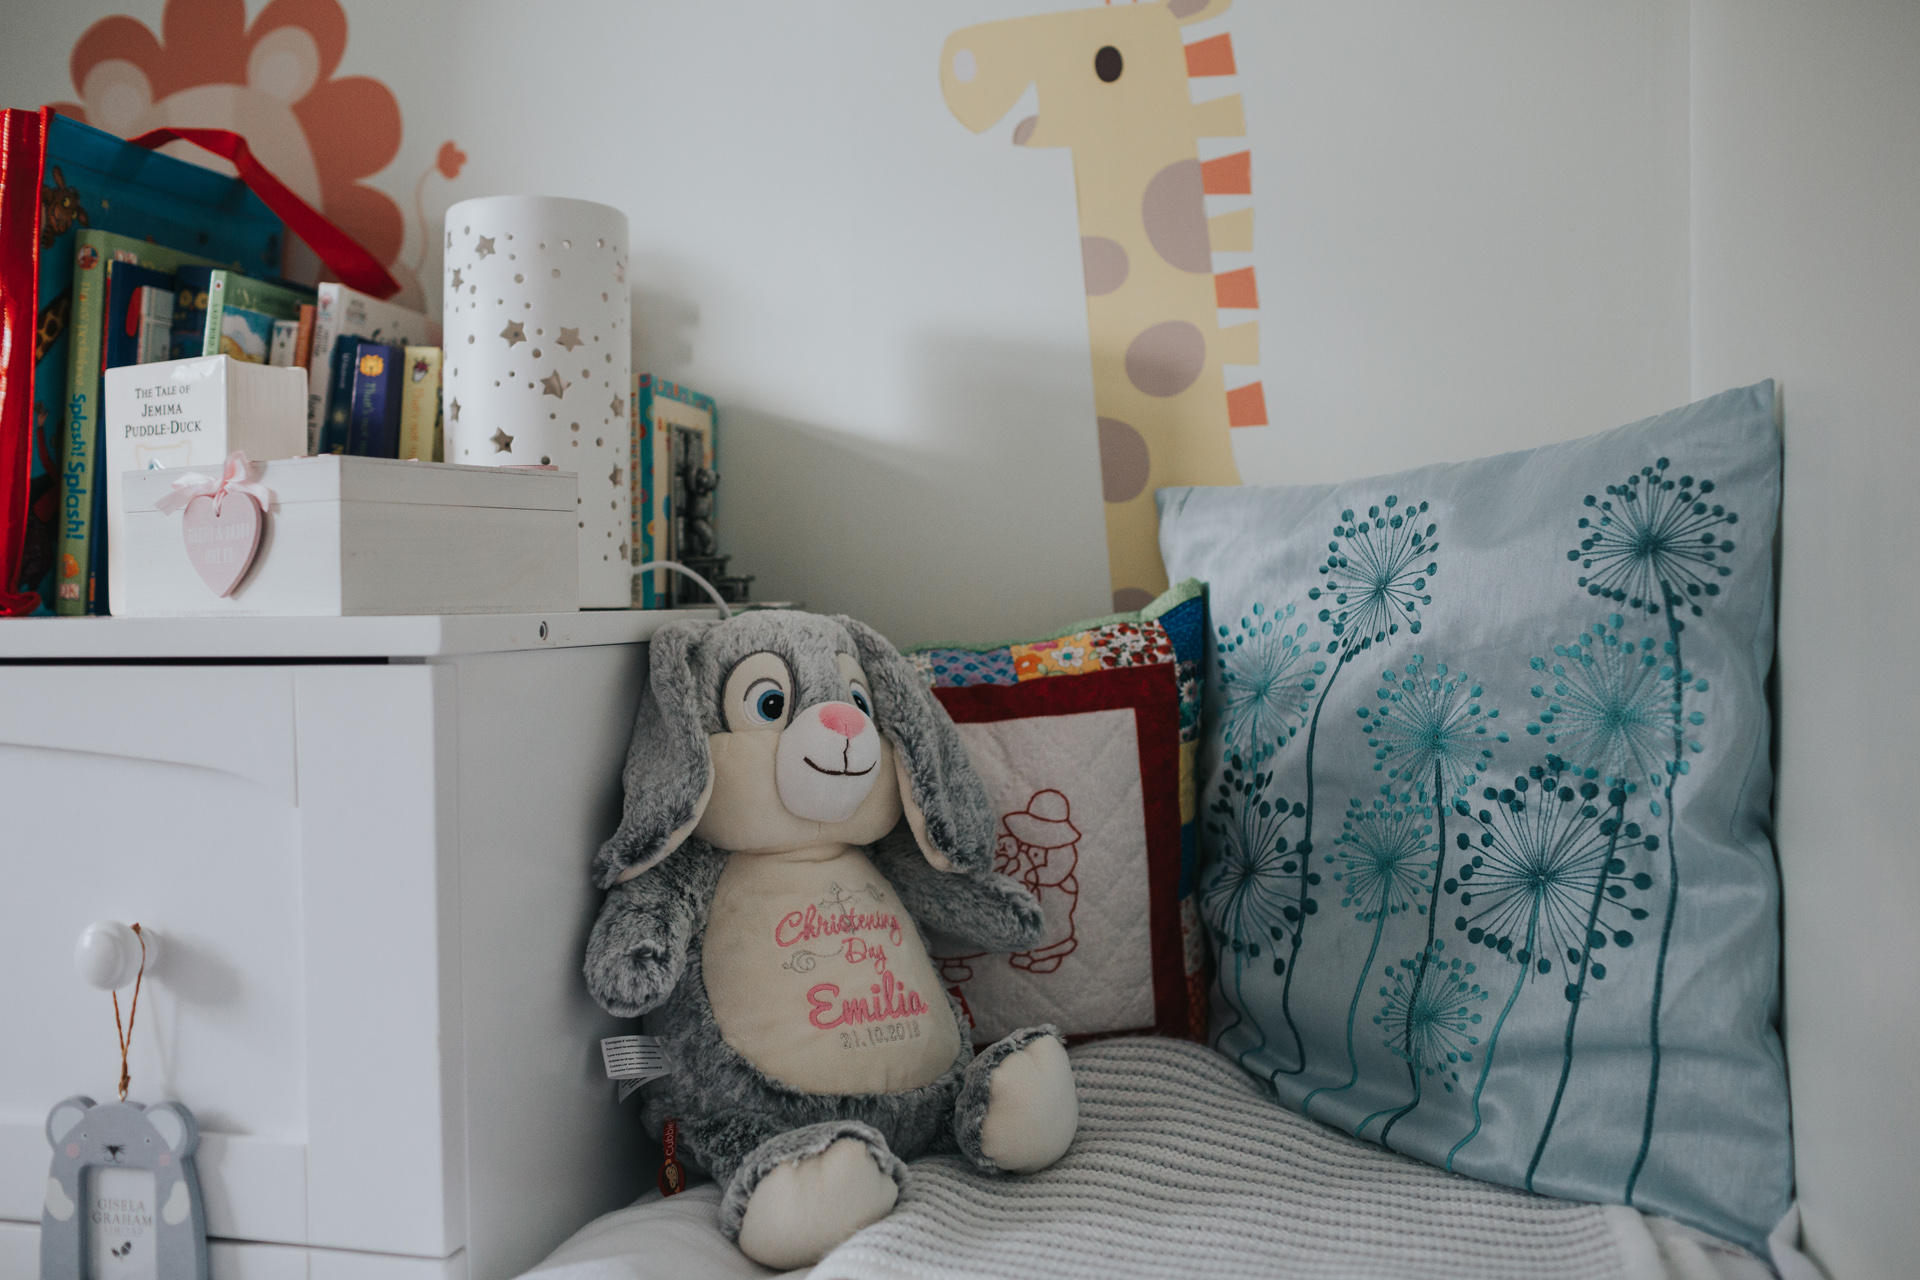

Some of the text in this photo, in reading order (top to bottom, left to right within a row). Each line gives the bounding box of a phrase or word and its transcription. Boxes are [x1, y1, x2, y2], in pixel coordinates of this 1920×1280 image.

[141, 403, 183, 417] JEMIMA
[125, 420, 202, 438] PUDDLE-DUCK
[63, 393, 87, 540] Splash! Splash!
[59, 583, 80, 599] DK
[775, 904, 903, 947] Christening
[842, 937, 887, 975] Day
[806, 970, 928, 1030] Emilia
[97, 1199, 145, 1212] GISELA
[92, 1212, 153, 1227] GRAHAM
